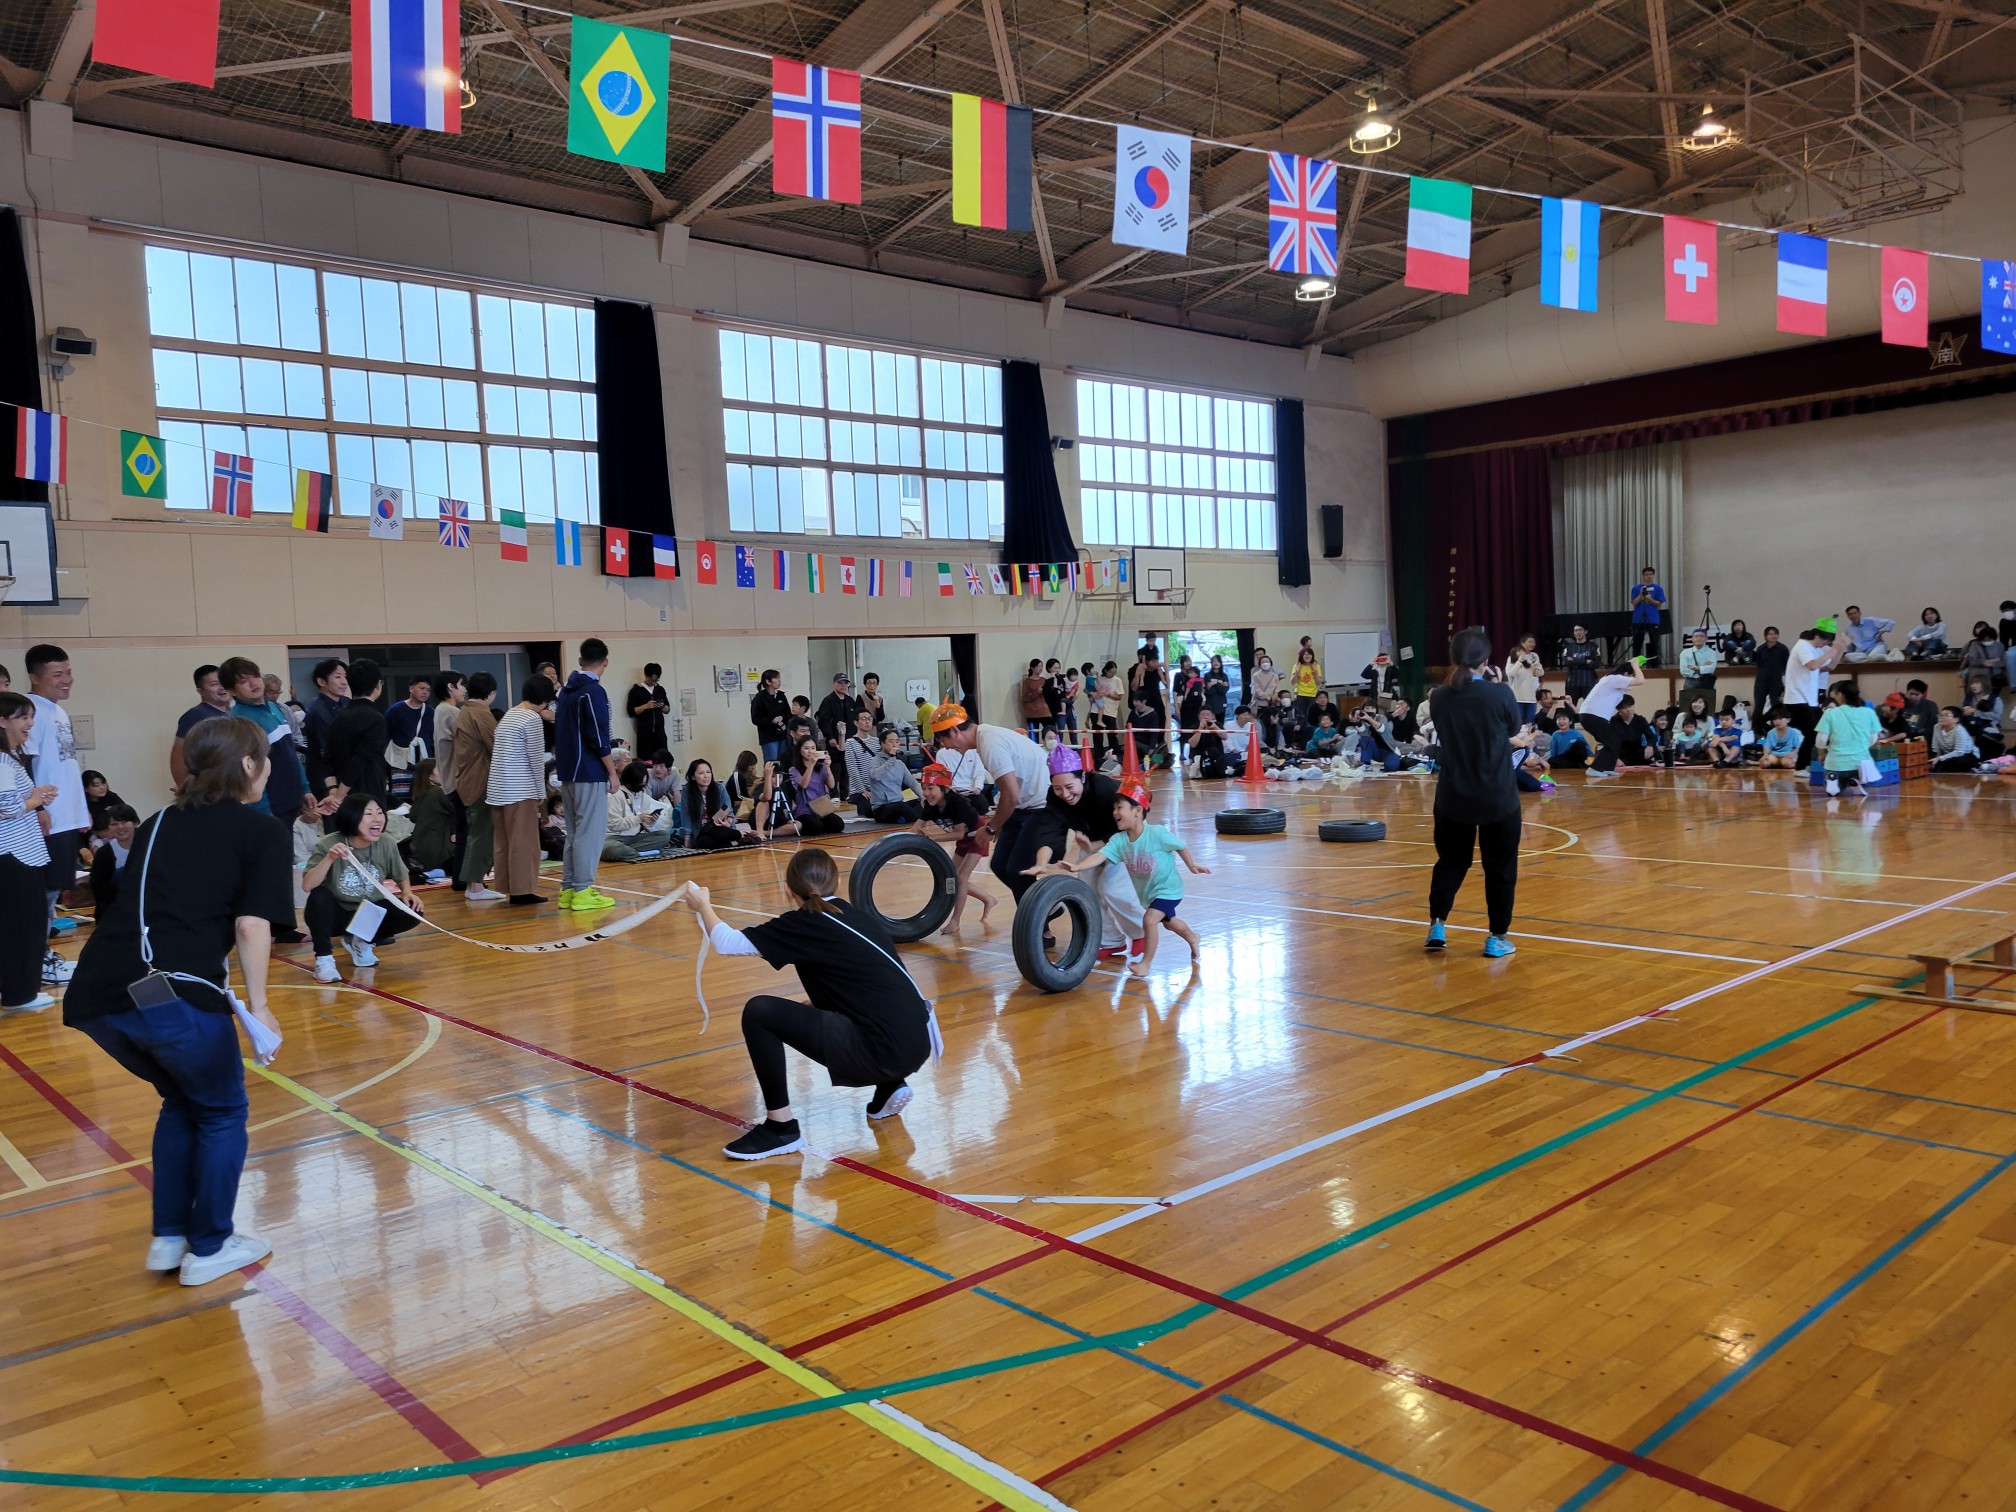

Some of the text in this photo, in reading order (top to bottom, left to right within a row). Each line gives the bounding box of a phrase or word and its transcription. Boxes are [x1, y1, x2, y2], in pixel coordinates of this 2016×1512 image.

[1937, 347, 1954, 364] 南
[909, 684, 927, 692] トイレ
